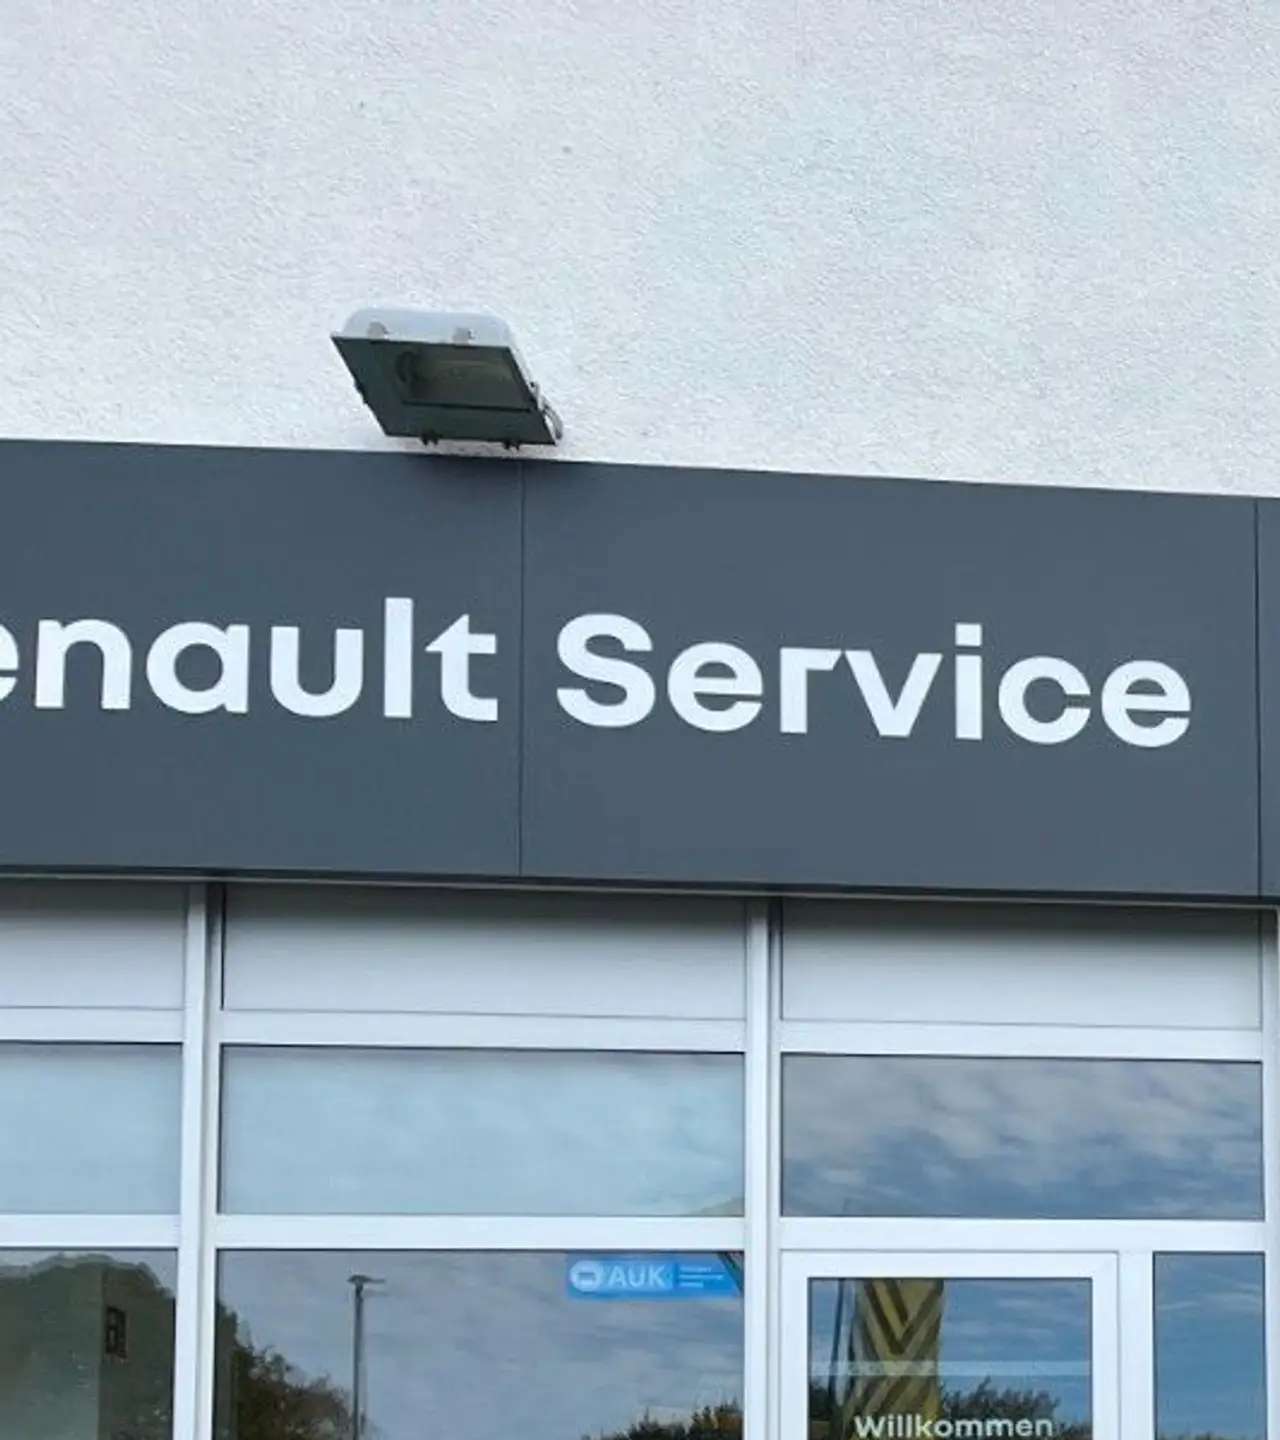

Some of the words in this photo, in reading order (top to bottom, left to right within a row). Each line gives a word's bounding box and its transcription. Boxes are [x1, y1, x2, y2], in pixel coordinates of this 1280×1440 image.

[0, 597, 499, 722] nault
[556, 612, 1191, 748] Service
[607, 1264, 668, 1288] AUK
[853, 1413, 1055, 1440] Willkommen
